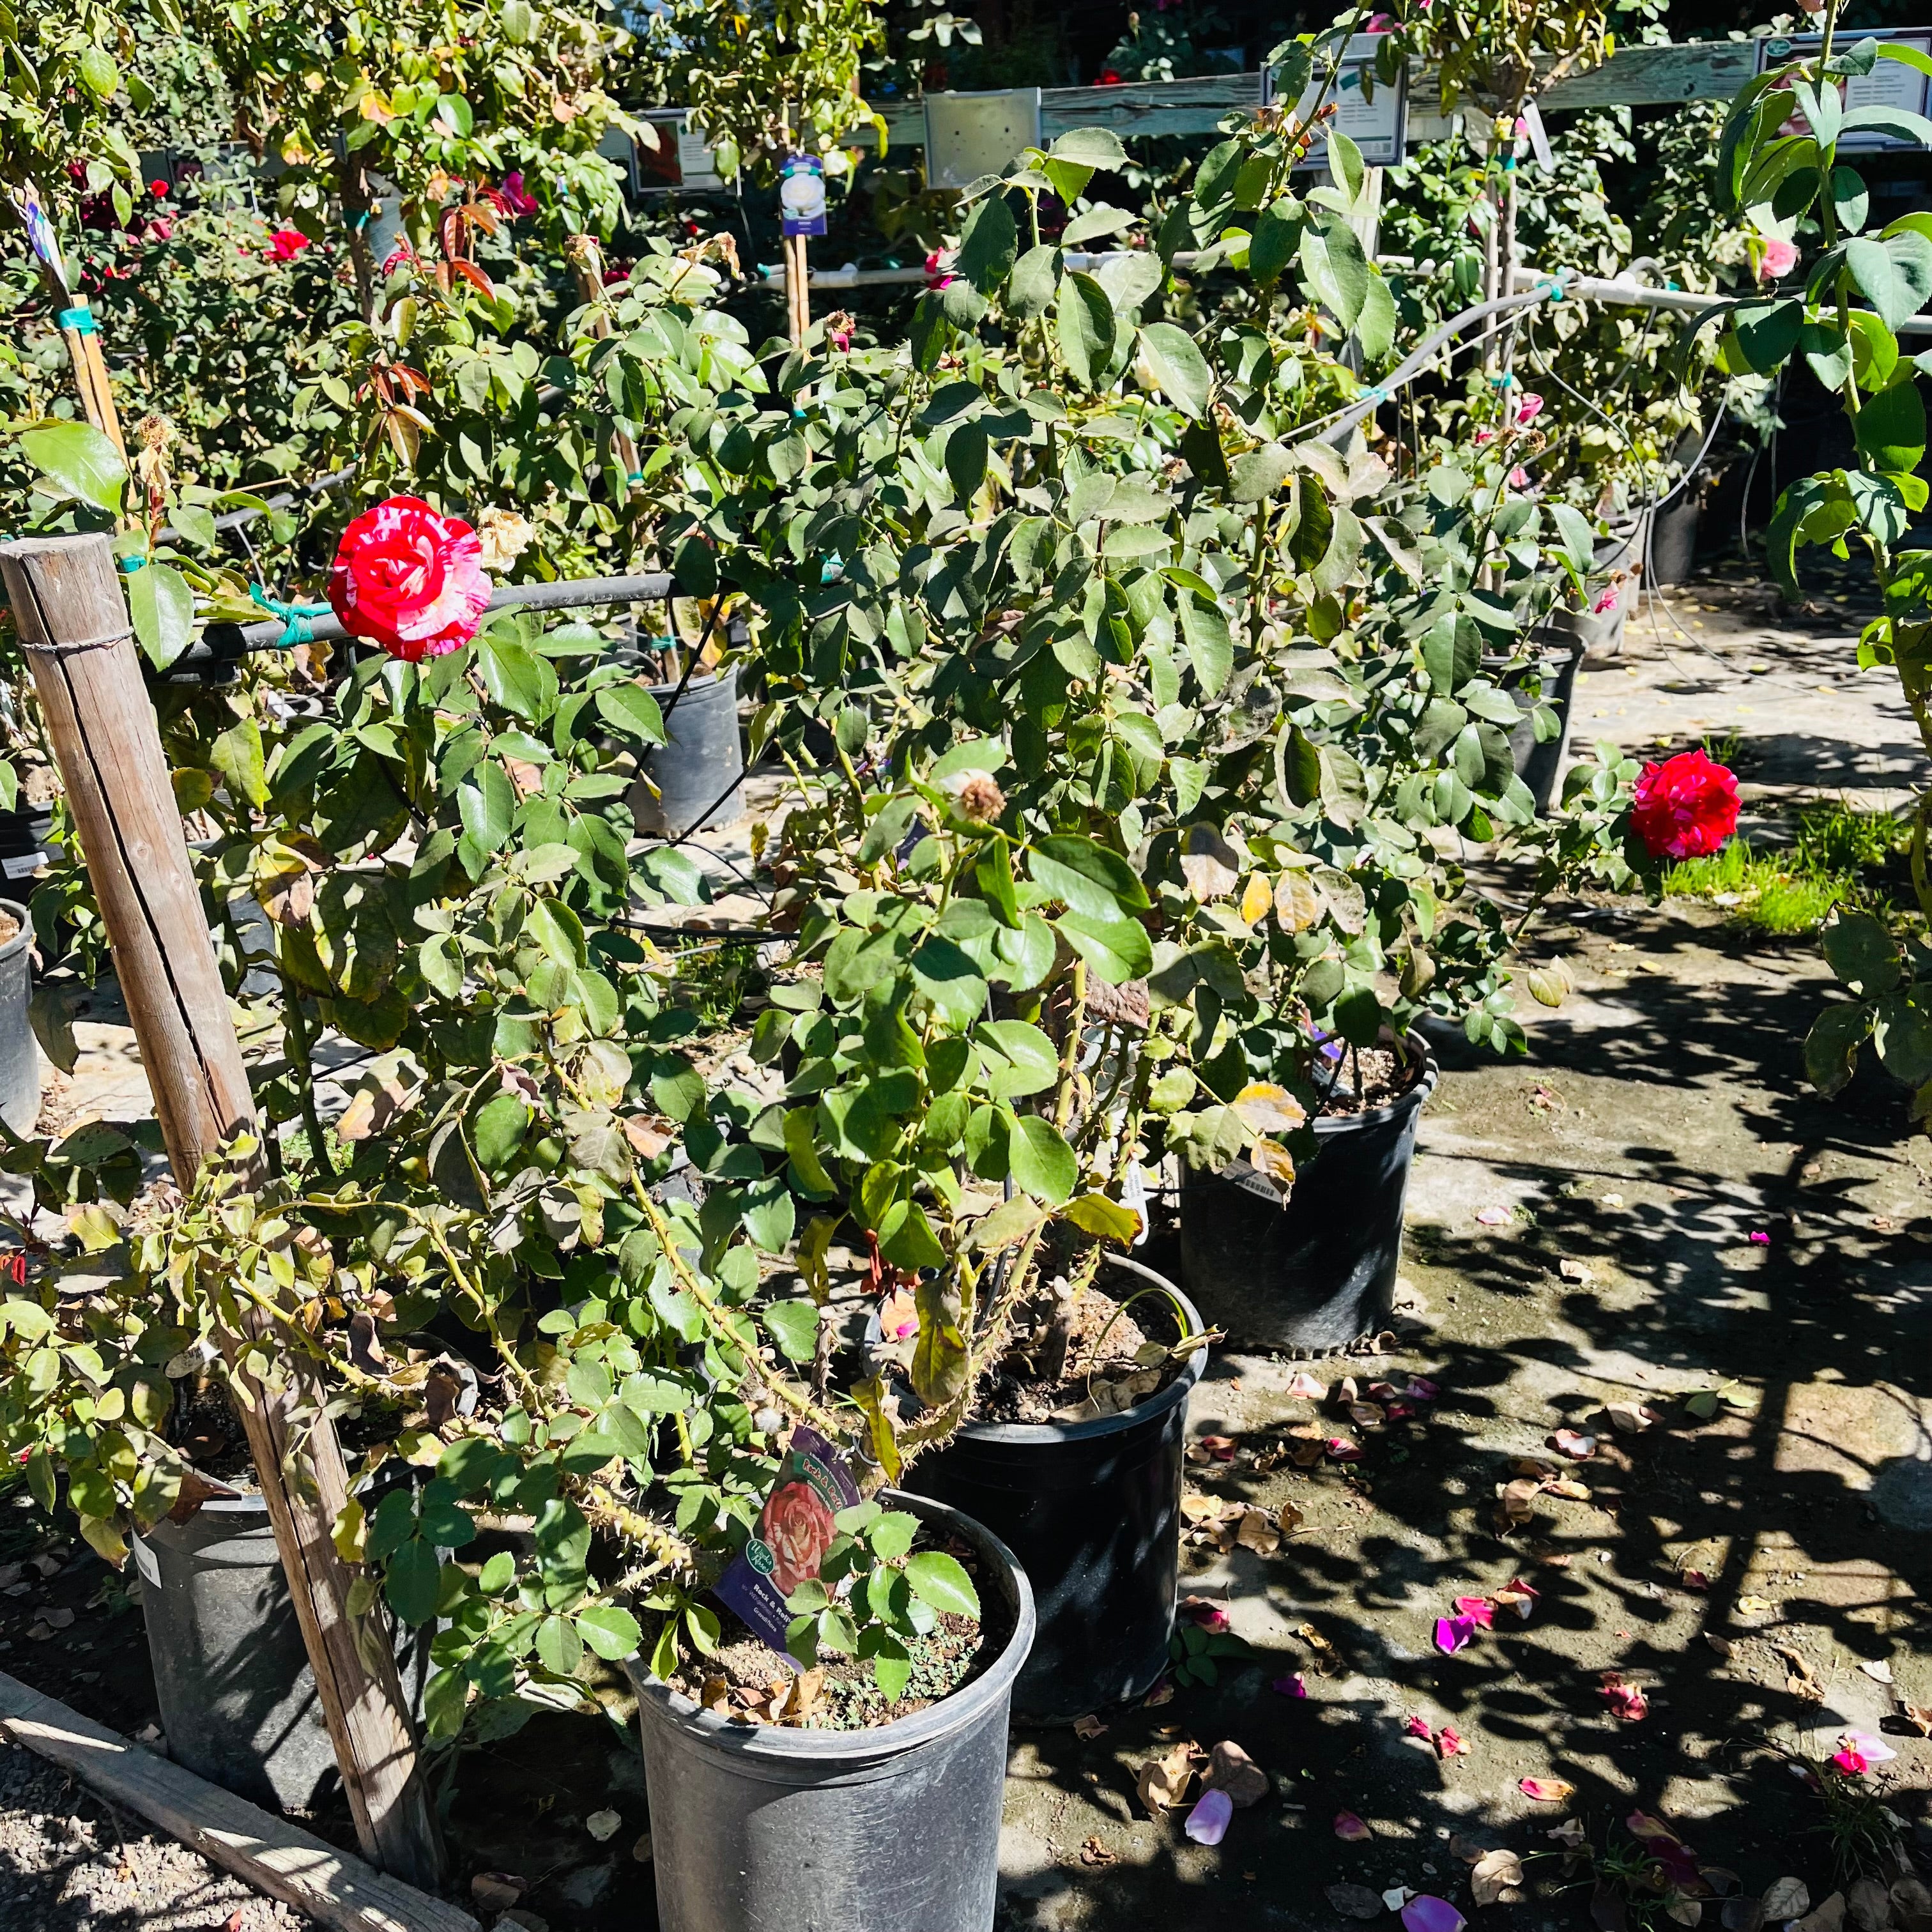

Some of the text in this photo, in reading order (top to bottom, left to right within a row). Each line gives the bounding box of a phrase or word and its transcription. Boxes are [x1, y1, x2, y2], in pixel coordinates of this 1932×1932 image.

[802, 1458, 821, 1480] Rock
[820, 1475, 829, 1488] &
[827, 1484, 843, 1510] Roll
[751, 1540, 772, 1565] Weeks
[751, 1554, 769, 1573] Roses
[754, 1584, 769, 1602] Rock
[769, 1600, 776, 1609] &
[754, 1607, 777, 1632] Grandiflora
